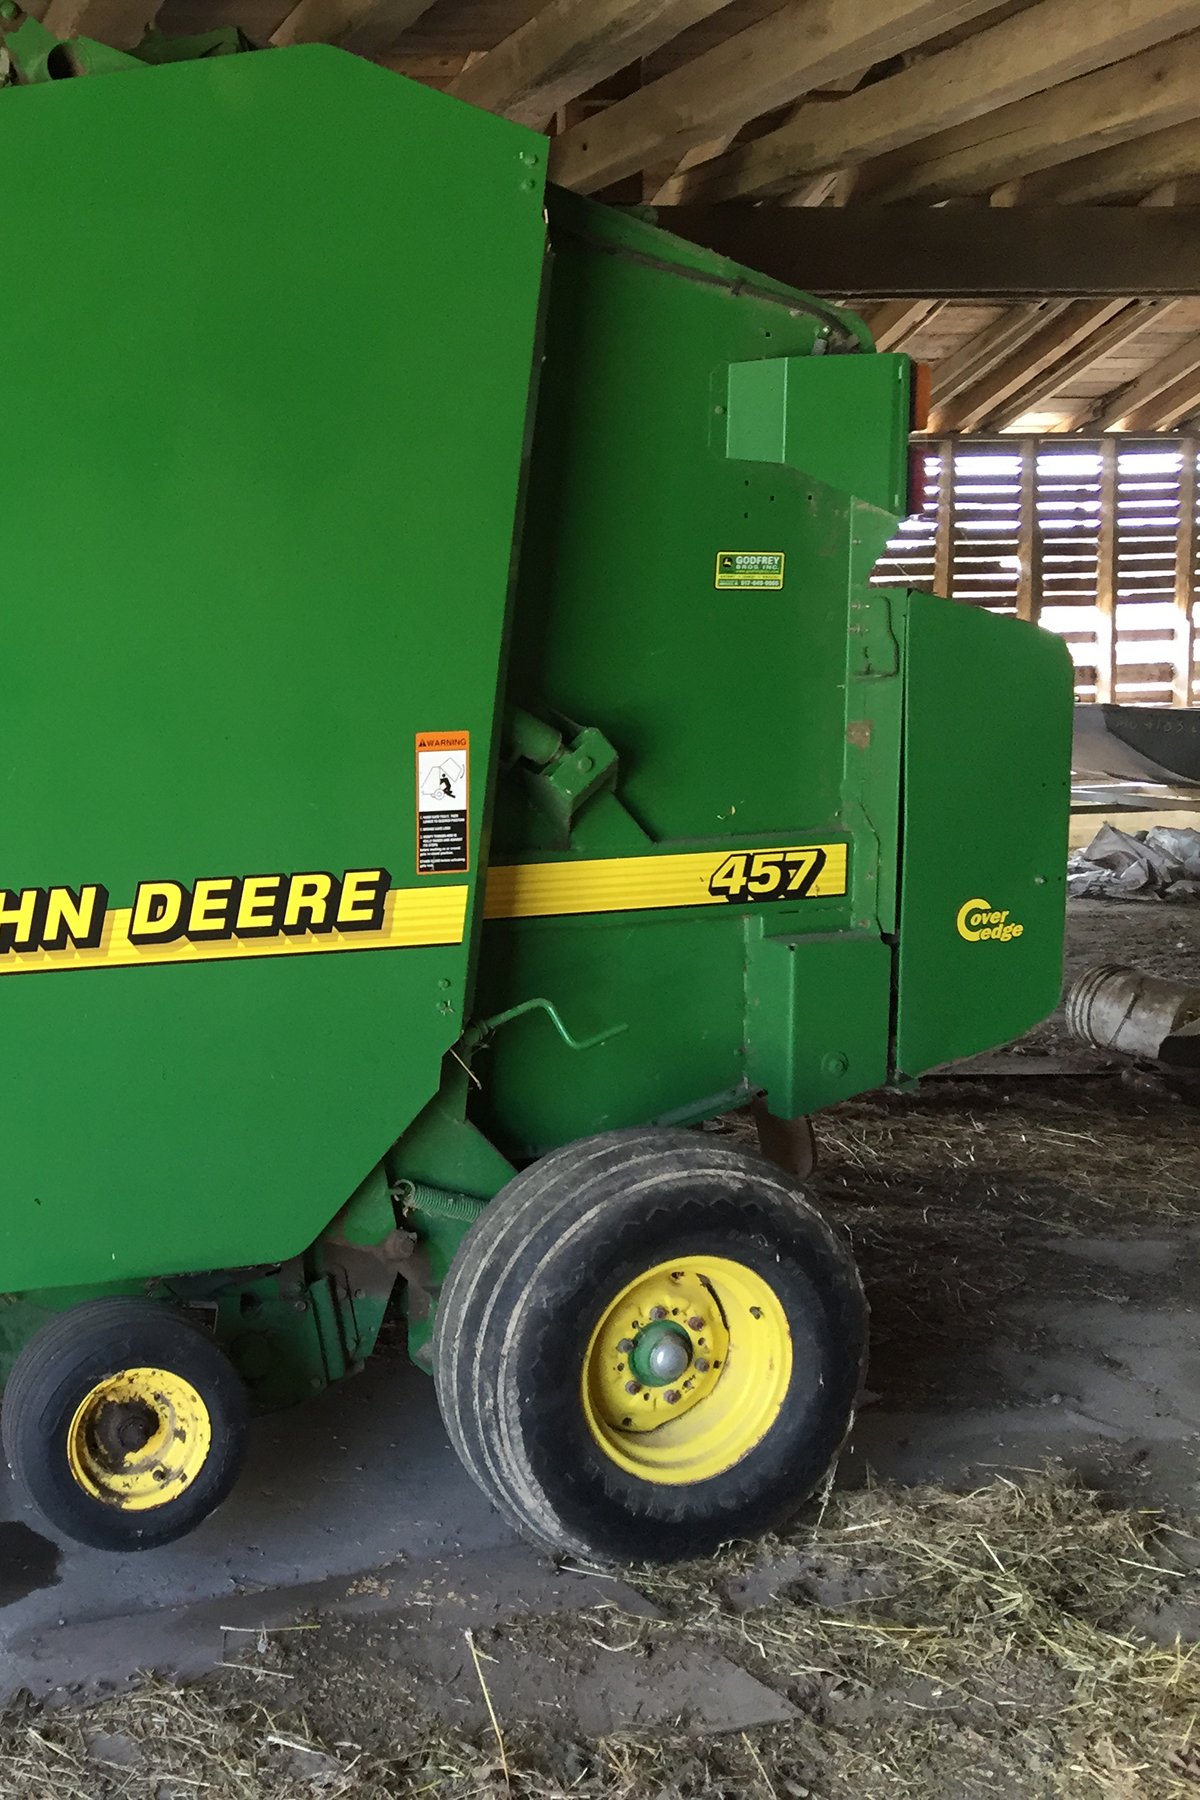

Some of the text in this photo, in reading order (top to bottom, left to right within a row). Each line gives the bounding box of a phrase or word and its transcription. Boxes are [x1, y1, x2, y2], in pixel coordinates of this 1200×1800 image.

[735, 556, 780, 565] GODFREY
[426, 737, 467, 747] WARNING
[707, 847, 827, 904] 457
[127, 867, 392, 946] DEERE
[956, 897, 1010, 942] Cover
[980, 922, 1024, 942] edge
